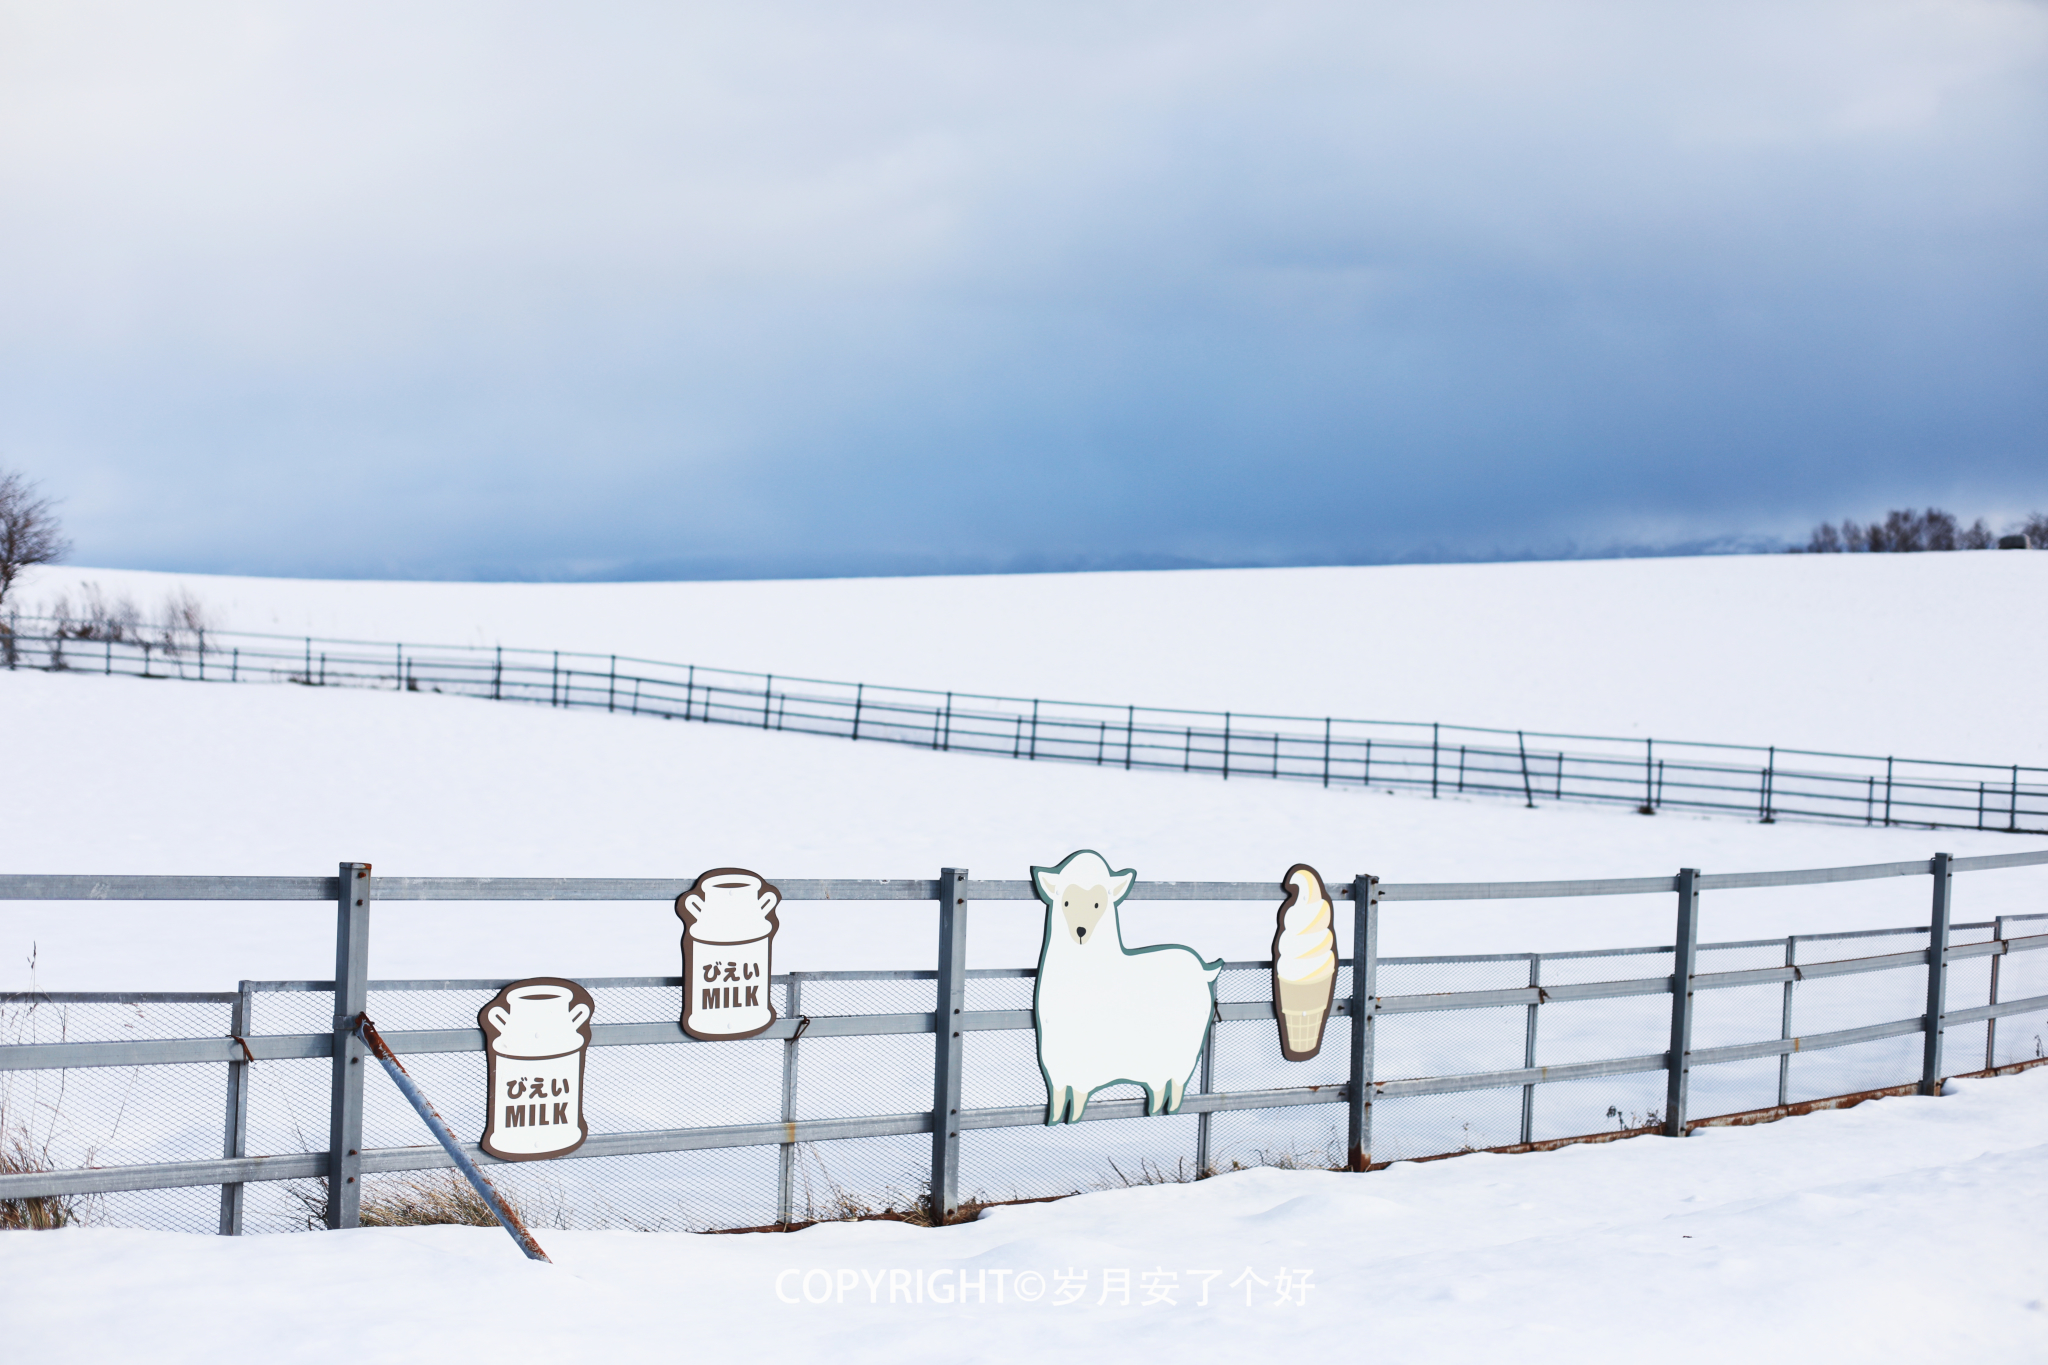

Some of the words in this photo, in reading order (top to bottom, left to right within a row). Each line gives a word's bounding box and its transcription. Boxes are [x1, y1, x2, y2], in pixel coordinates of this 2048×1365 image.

[702, 961, 760, 983] びえい
[701, 985, 759, 1010] MILK
[505, 1076, 570, 1100] びえい
[505, 1102, 569, 1128] MILK
